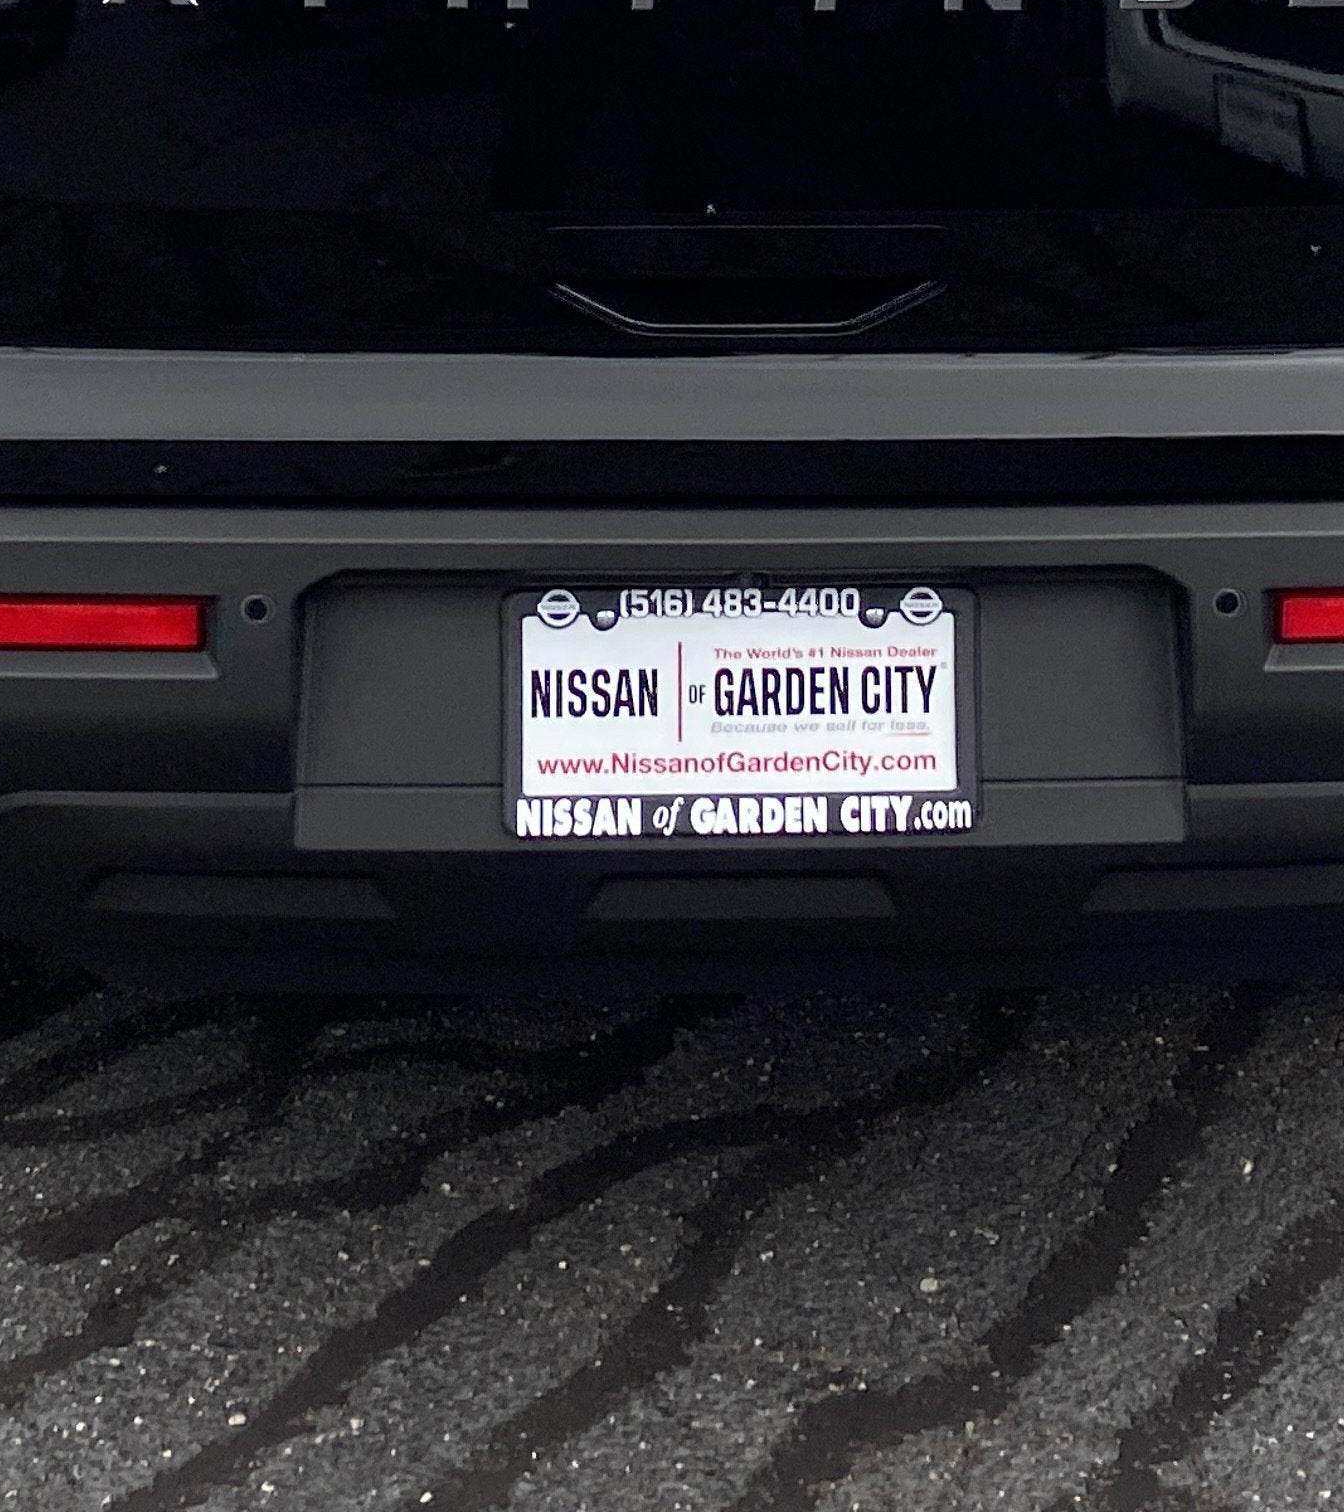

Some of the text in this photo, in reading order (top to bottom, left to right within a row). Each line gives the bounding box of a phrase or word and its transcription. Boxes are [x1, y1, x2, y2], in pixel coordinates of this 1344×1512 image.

[619, 587, 860, 618] (516) 483-4400
[714, 648, 741, 660] The
[747, 647, 803, 660] World's
[830, 646, 882, 659] Nissan
[887, 645, 938, 658] Dealer
[531, 665, 937, 718] NISSAN OF GARDEN CITY
[711, 721, 787, 734] Because
[538, 750, 936, 775] www.NissanofGardenCity.com
[516, 795, 972, 837] NISSAN of GARDEN CITY.com
